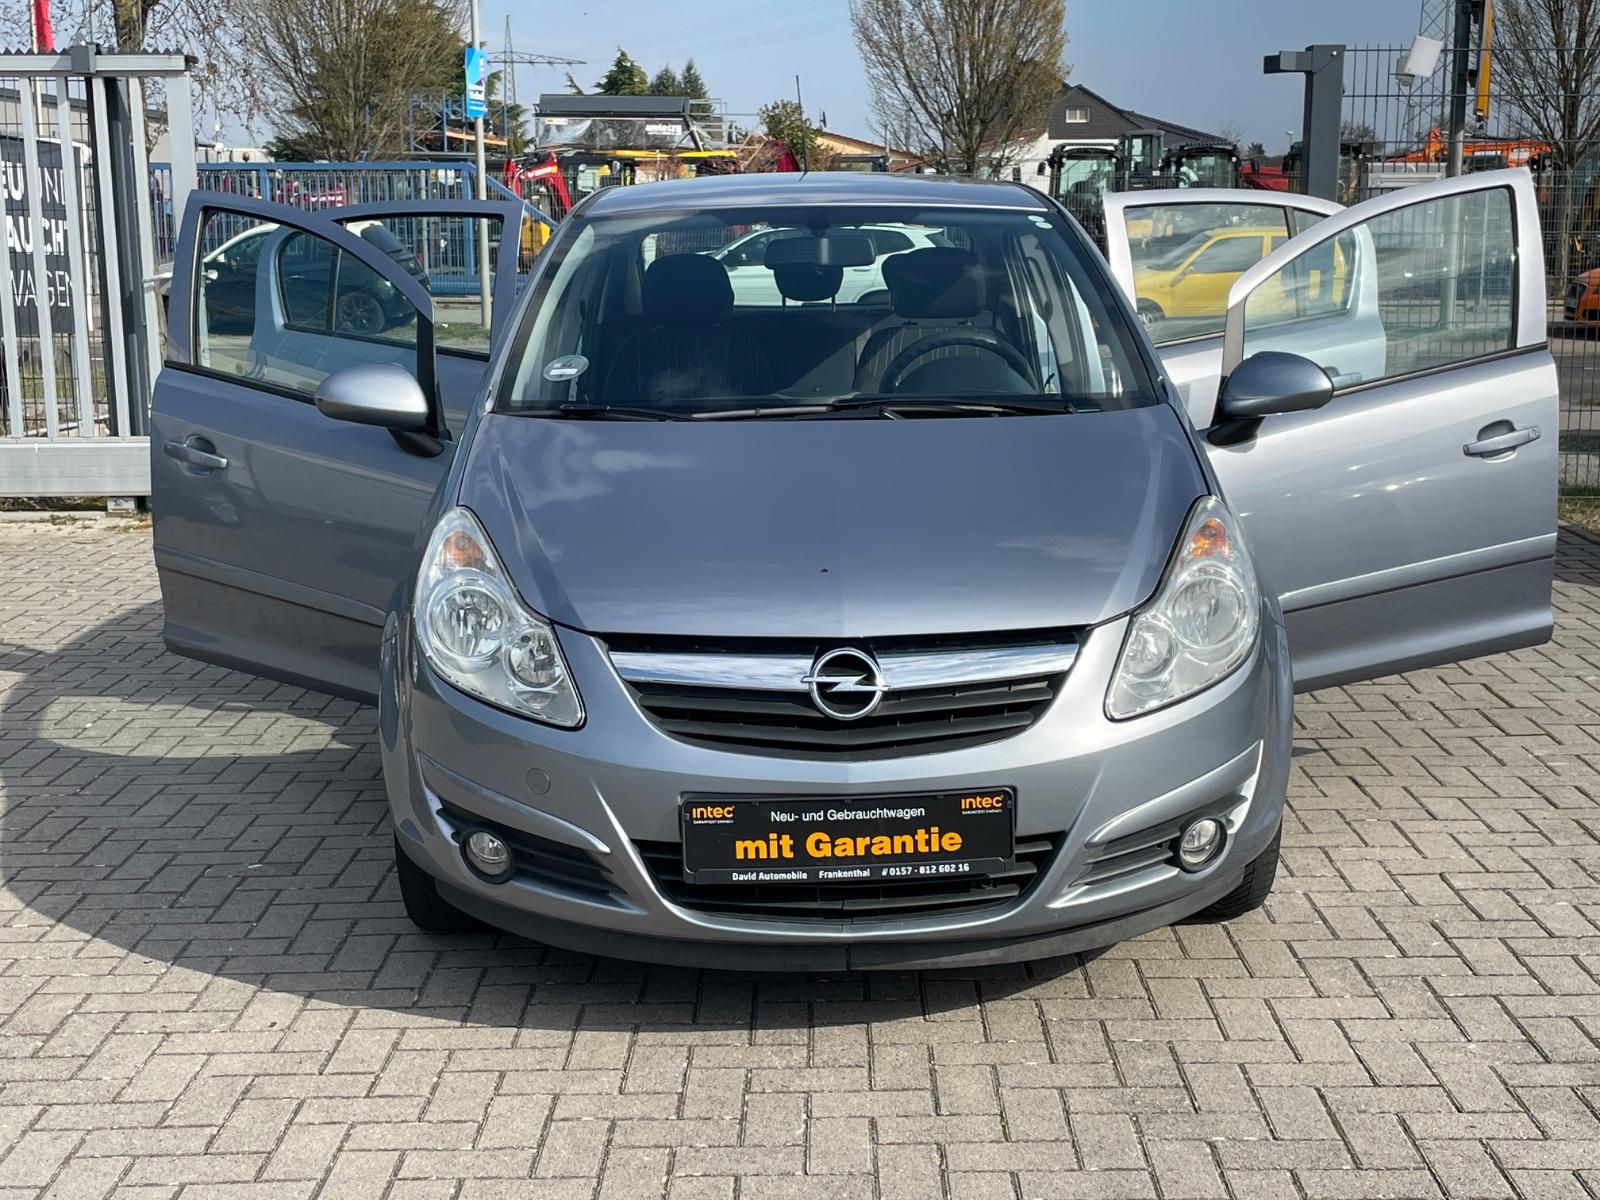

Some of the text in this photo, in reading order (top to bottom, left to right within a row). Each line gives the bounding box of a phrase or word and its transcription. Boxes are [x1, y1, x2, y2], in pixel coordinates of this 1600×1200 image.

[961, 794, 1004, 809] intec
[692, 805, 735, 819] intec
[770, 806, 926, 823] Neu- und Gebrauchtwagen
[735, 826, 963, 860] mit Garantie
[732, 871, 757, 881] David
[758, 871, 808, 881] Automobile
[818, 868, 871, 879] Frankenthal
[889, 866, 913, 876] 0157
[919, 865, 937, 875] 812
[938, 864, 956, 873] 602
[957, 863, 970, 872] 16
